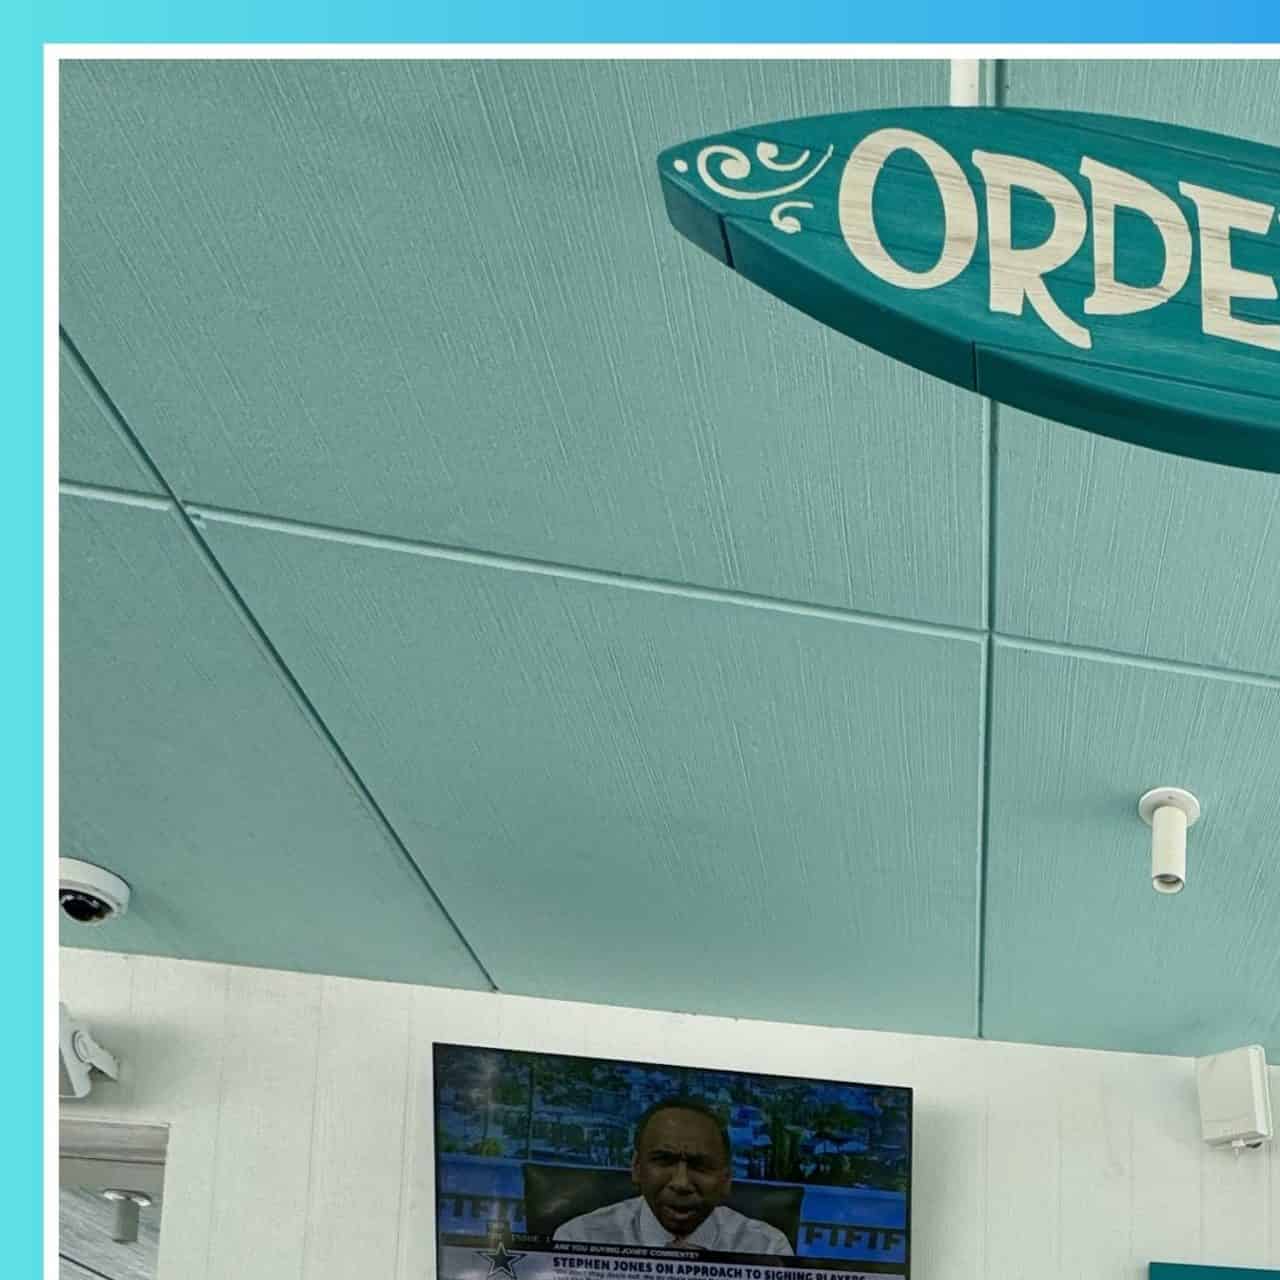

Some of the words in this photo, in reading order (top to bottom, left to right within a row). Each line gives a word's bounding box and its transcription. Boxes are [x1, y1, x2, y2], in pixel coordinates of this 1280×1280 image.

[553, 1257, 610, 1270] STEPHEN
[613, 1260, 652, 1272] JONES
[656, 1263, 674, 1274] ON
[676, 1264, 743, 1280] APPROACH
[746, 1269, 761, 1280] TO
